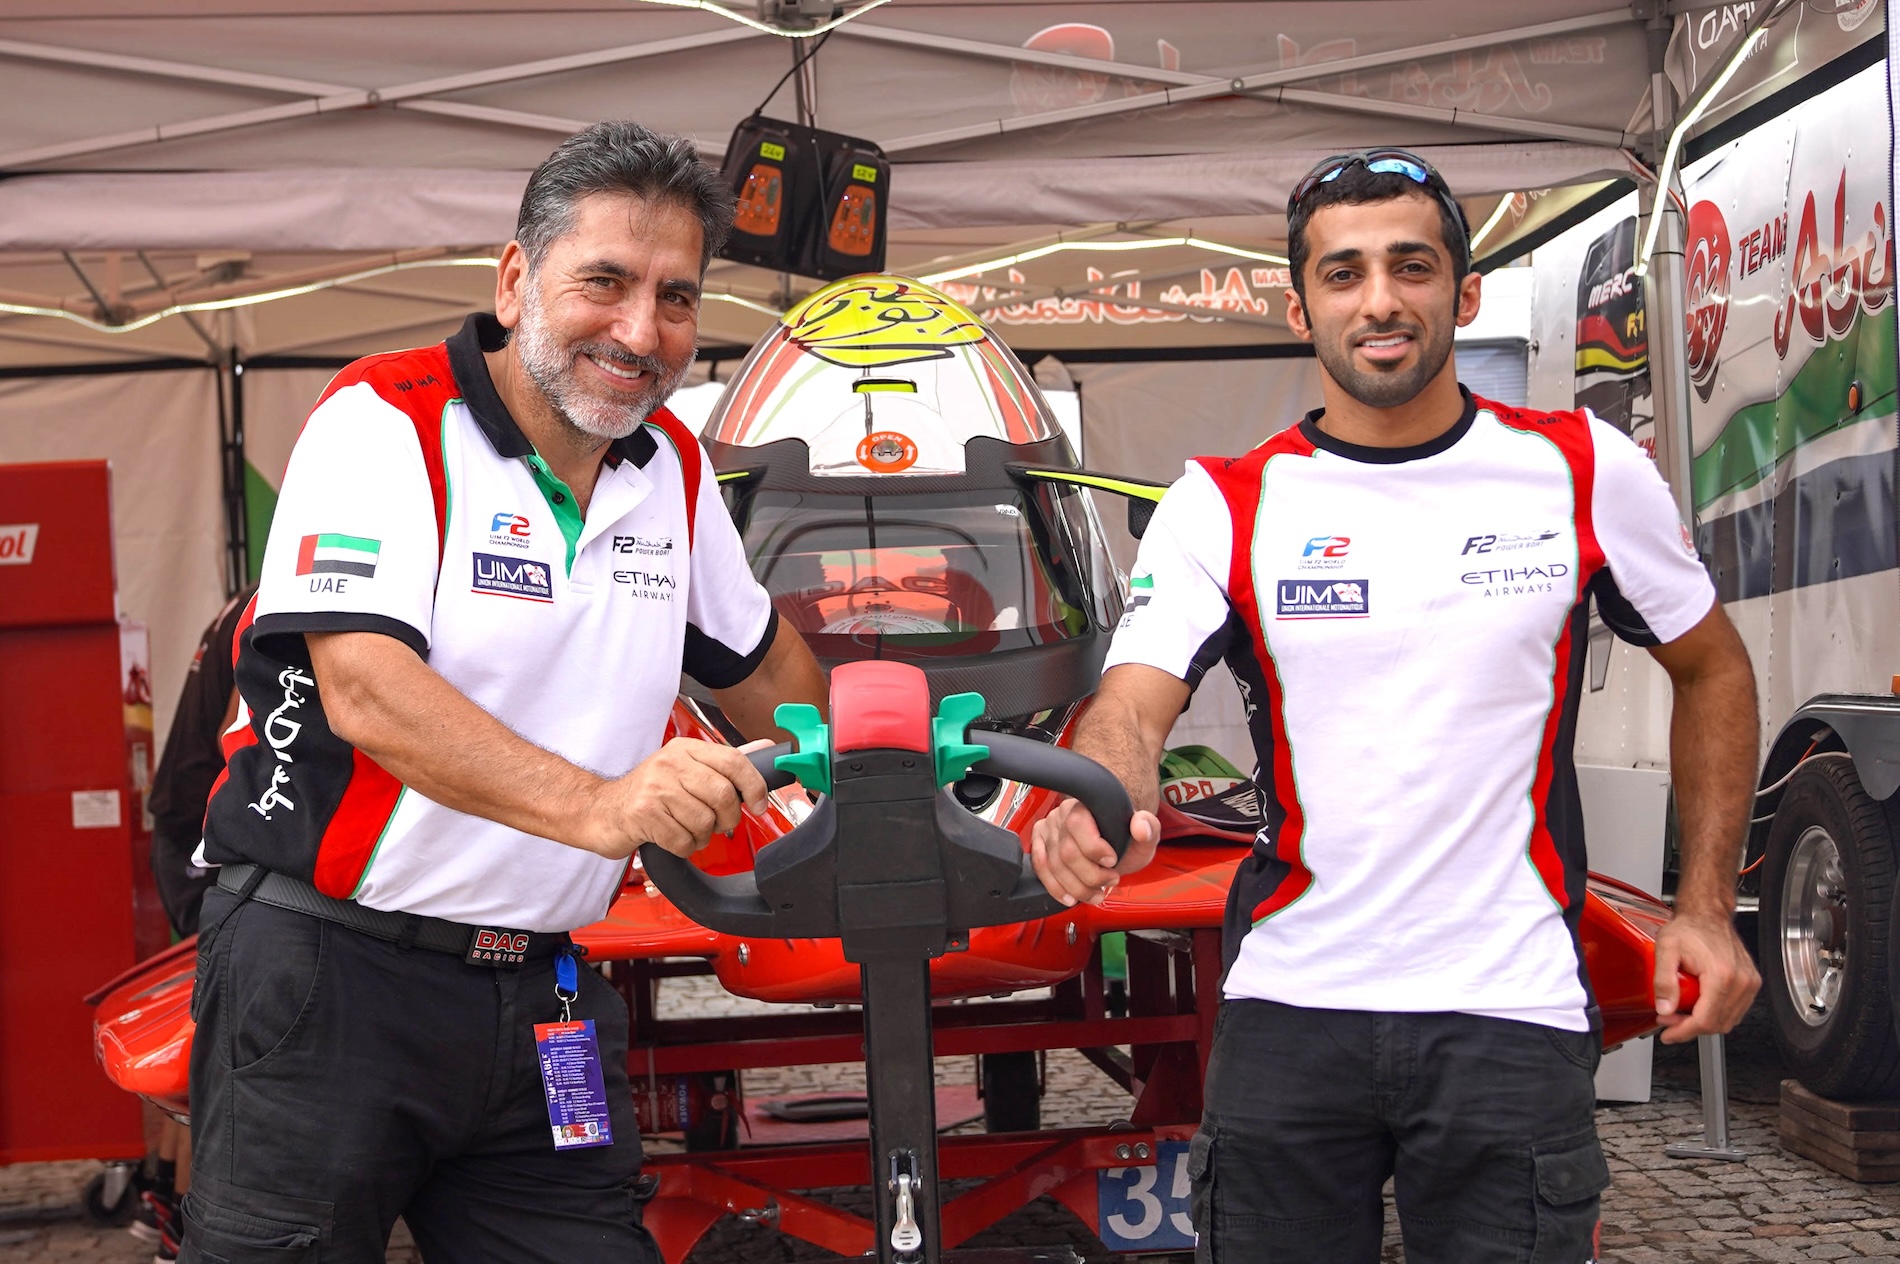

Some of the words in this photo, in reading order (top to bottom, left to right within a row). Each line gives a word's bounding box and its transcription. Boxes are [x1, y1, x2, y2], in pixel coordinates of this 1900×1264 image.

[1739, 212, 1788, 280] TEAM
[871, 434, 903, 442] OPEN
[491, 512, 531, 537] F2
[612, 535, 636, 554] F2
[1302, 535, 1351, 557] F2
[1460, 534, 1497, 556] F2
[477, 558, 524, 584] UIM
[1460, 563, 1569, 585] ETIHAD
[309, 577, 349, 594] UAE
[1281, 585, 1333, 605] UIM
[1483, 582, 1553, 598] AIRWAYS
[1163, 780, 1216, 807] DAC
[474, 929, 530, 954] DAC
[471, 950, 525, 963] RACING
[541, 1052, 559, 1105] TIMETABLE
[678, 1084, 688, 1123] POWDER
